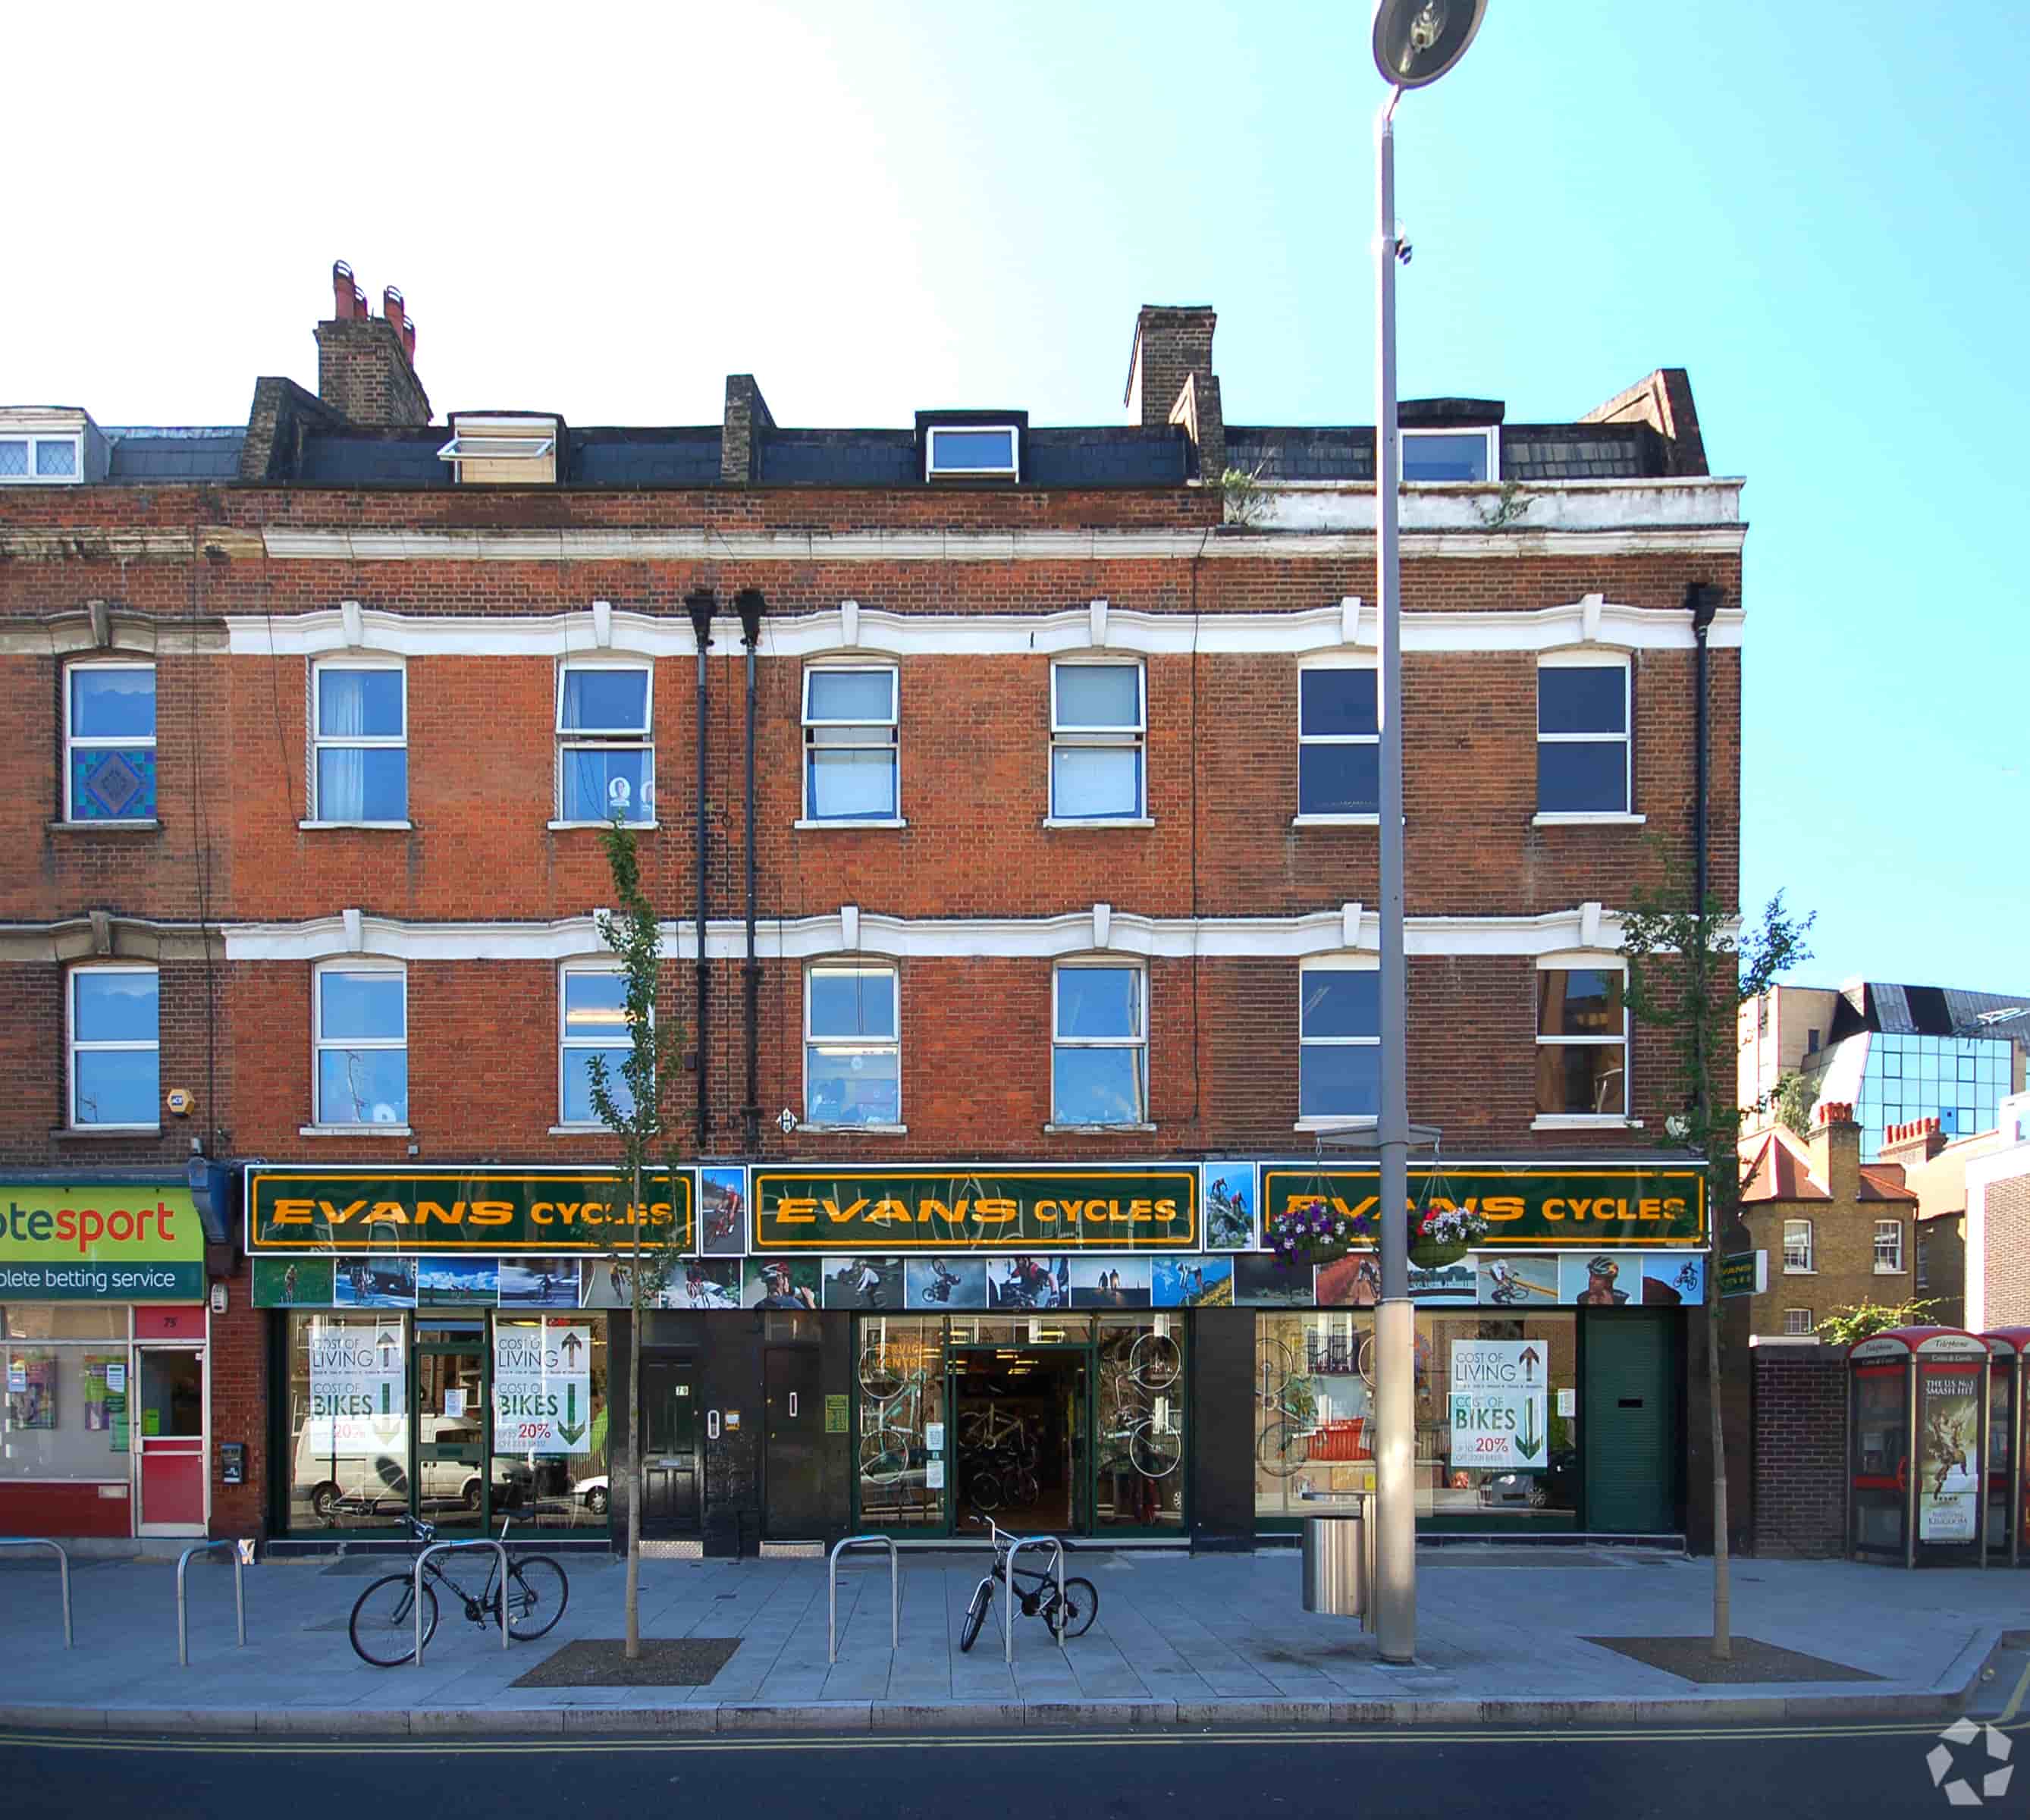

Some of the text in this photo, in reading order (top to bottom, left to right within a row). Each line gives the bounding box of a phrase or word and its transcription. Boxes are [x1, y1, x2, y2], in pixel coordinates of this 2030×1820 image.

[272, 1199, 515, 1225] EVANS
[776, 1198, 1177, 1223] EVANS CYCLES
[1287, 1194, 1686, 1222] VNS CYCLES
[0, 1201, 175, 1253] tesport
[45, 1269, 107, 1292] betting
[111, 1269, 176, 1288] service
[530, 1338, 544, 1350] O
[312, 1350, 374, 1368] LIVING
[497, 1350, 559, 1368] LIVING
[1455, 1352, 1505, 1363] COST OF
[1455, 1363, 1517, 1382] LIVING
[314, 1382, 361, 1395] COST OF
[497, 1382, 528, 1395] COST
[313, 1394, 373, 1416] BIKES
[498, 1394, 559, 1417] BIKES
[1487, 1396, 1504, 1407] OF
[1455, 1408, 1516, 1430] BIKES
[519, 1423, 551, 1439] 20%
[1476, 1437, 1508, 1452] 20%
